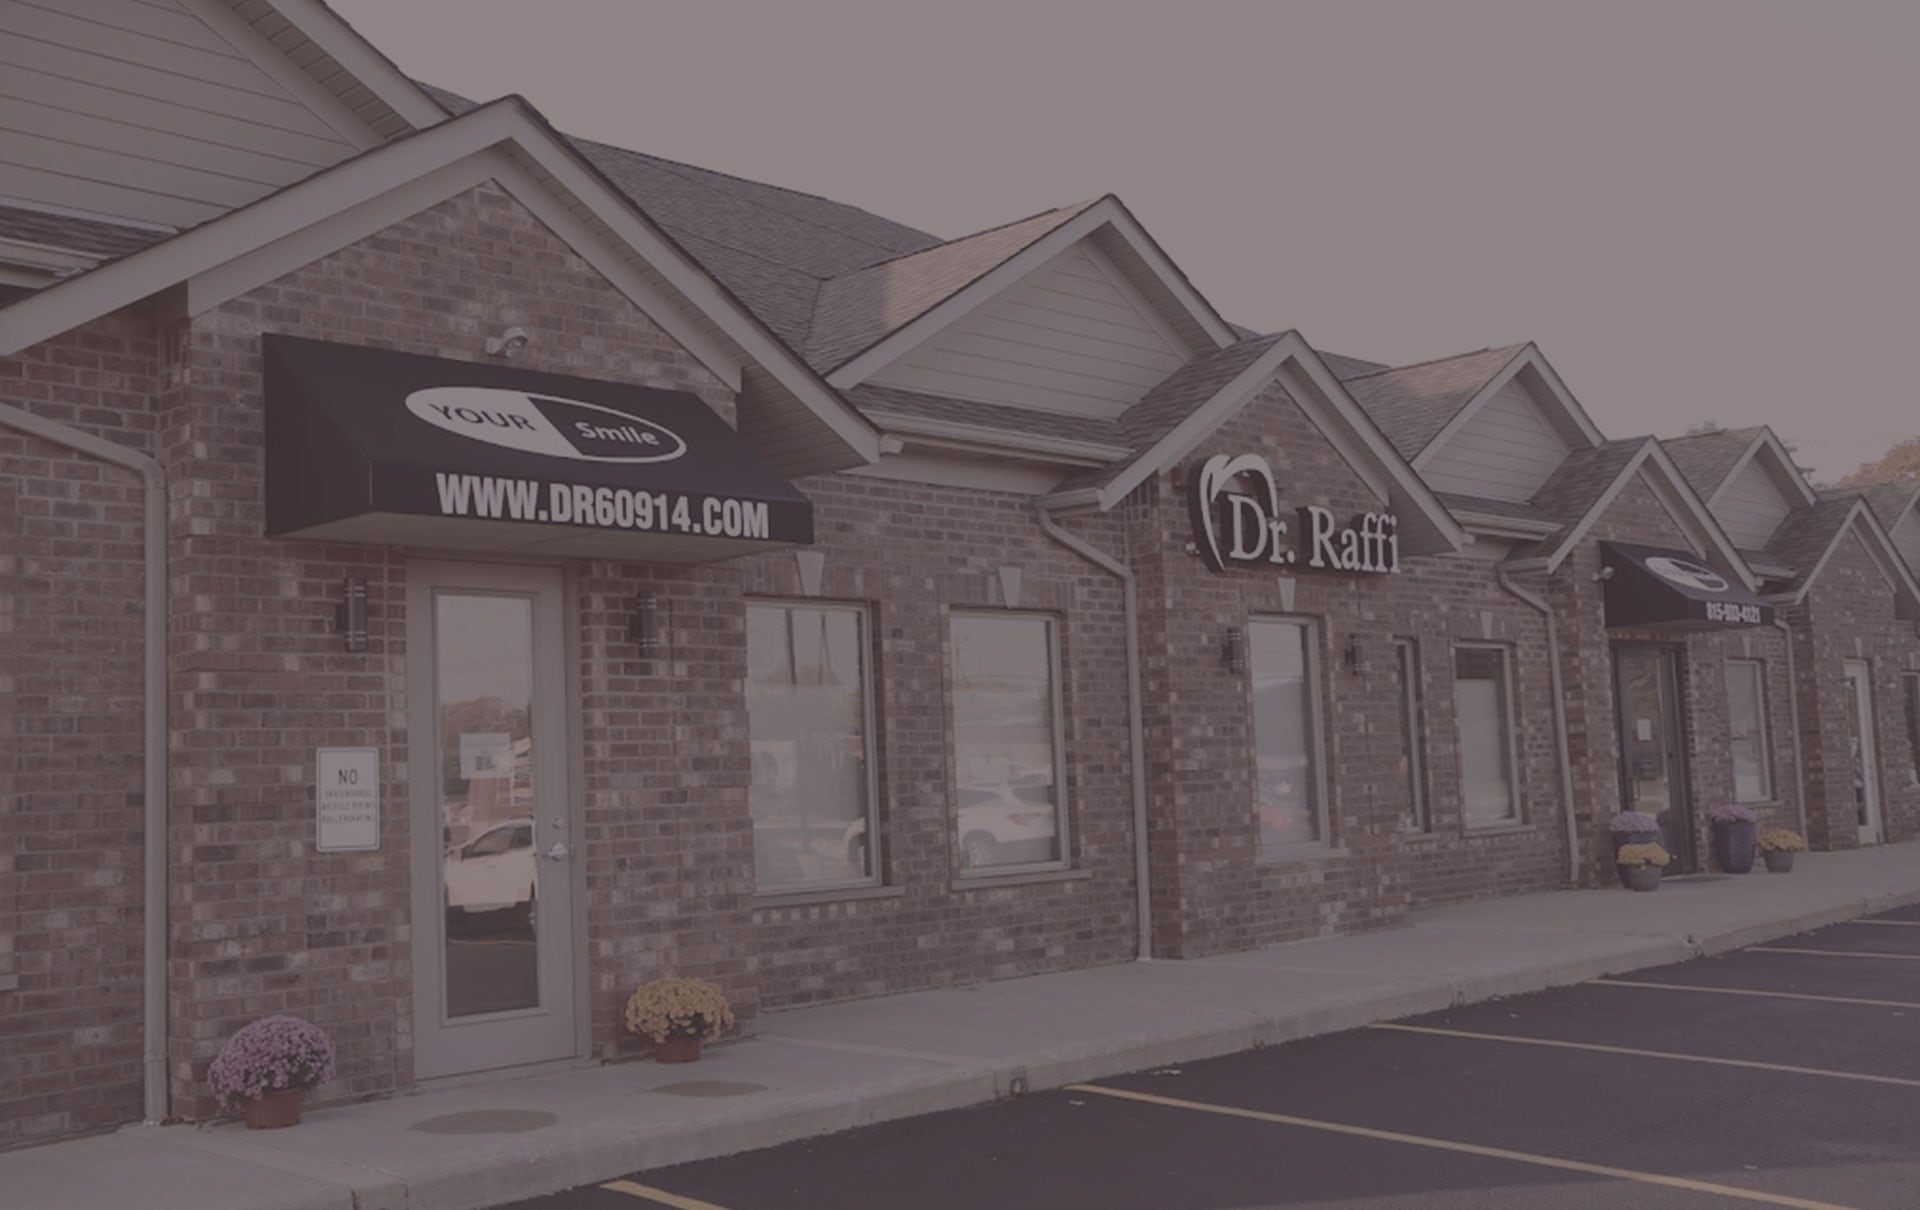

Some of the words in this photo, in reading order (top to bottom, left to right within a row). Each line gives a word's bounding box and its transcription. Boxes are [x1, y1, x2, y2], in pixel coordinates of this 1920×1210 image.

[428, 403, 536, 432] YOUR
[575, 421, 658, 447] Smile
[436, 472, 769, 540] WWW.DR60914.COM
[1228, 494, 1295, 564] Dr.
[1307, 505, 1401, 573] Raffi
[338, 769, 358, 785] NO
